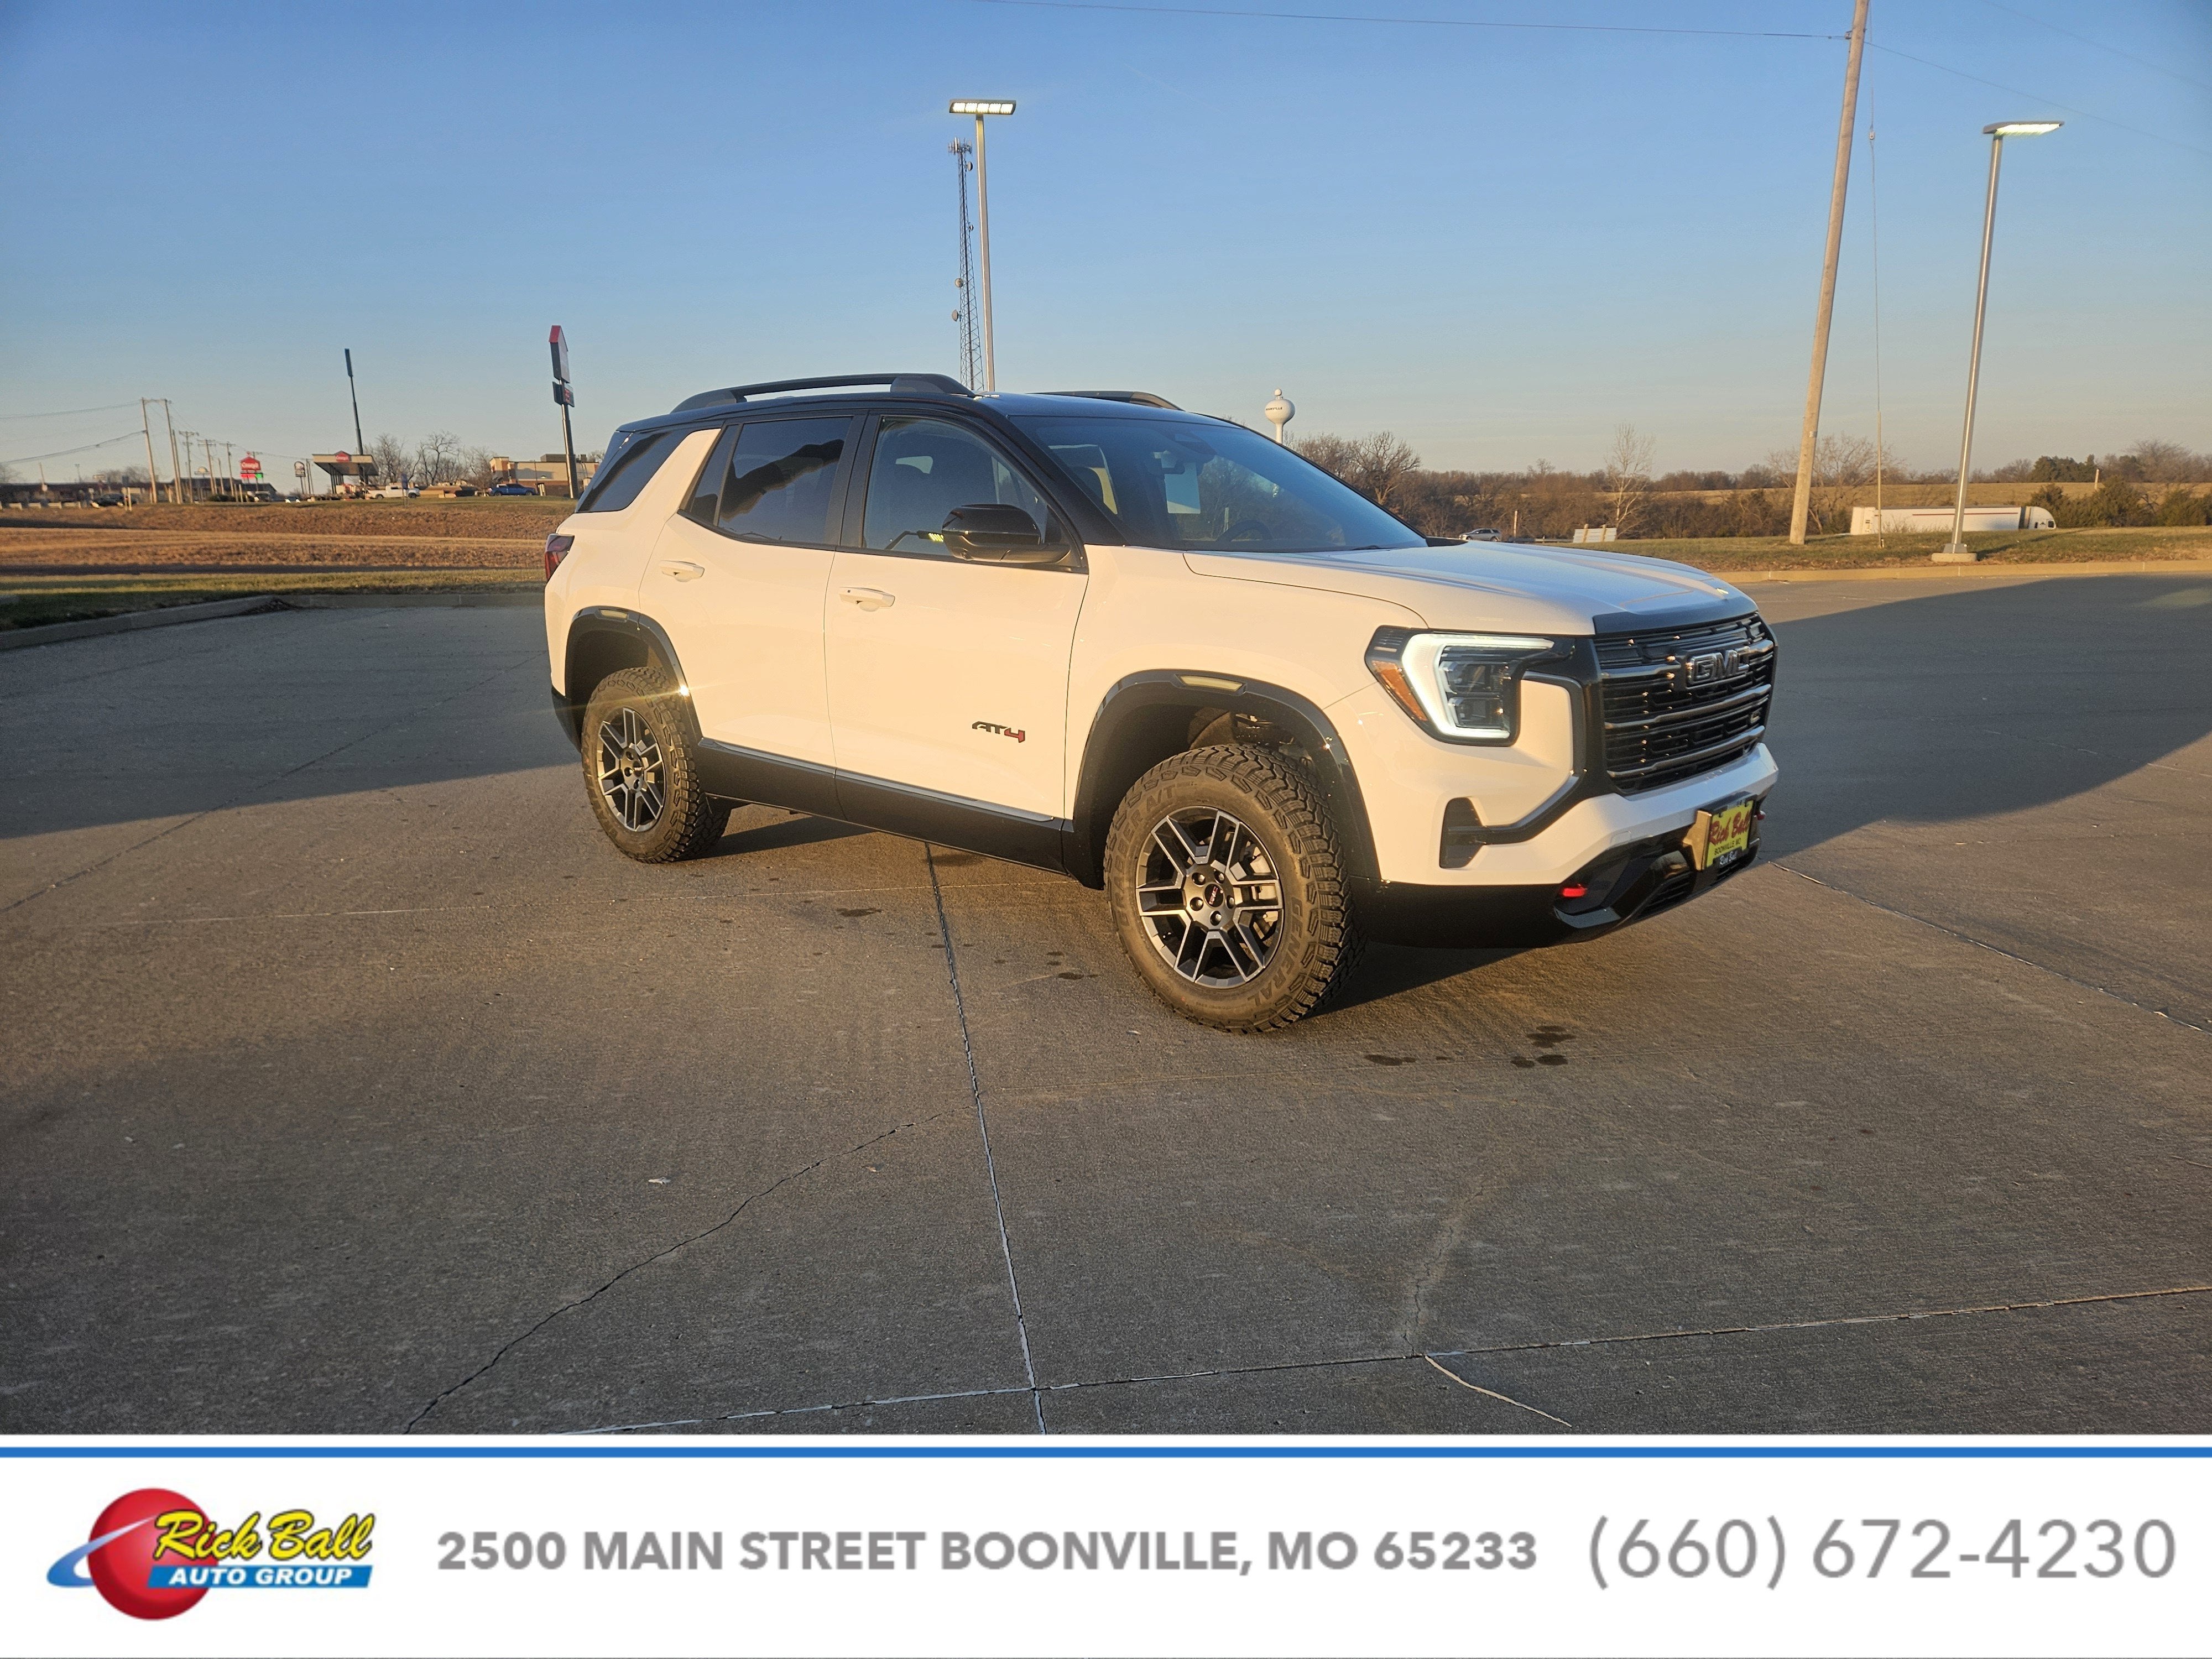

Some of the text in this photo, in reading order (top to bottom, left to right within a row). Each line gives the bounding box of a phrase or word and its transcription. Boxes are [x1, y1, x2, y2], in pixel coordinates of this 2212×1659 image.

[1689, 645, 1751, 685] GMC
[972, 721, 1025, 743] AT4
[1247, 896, 1303, 1006] GENERAL
